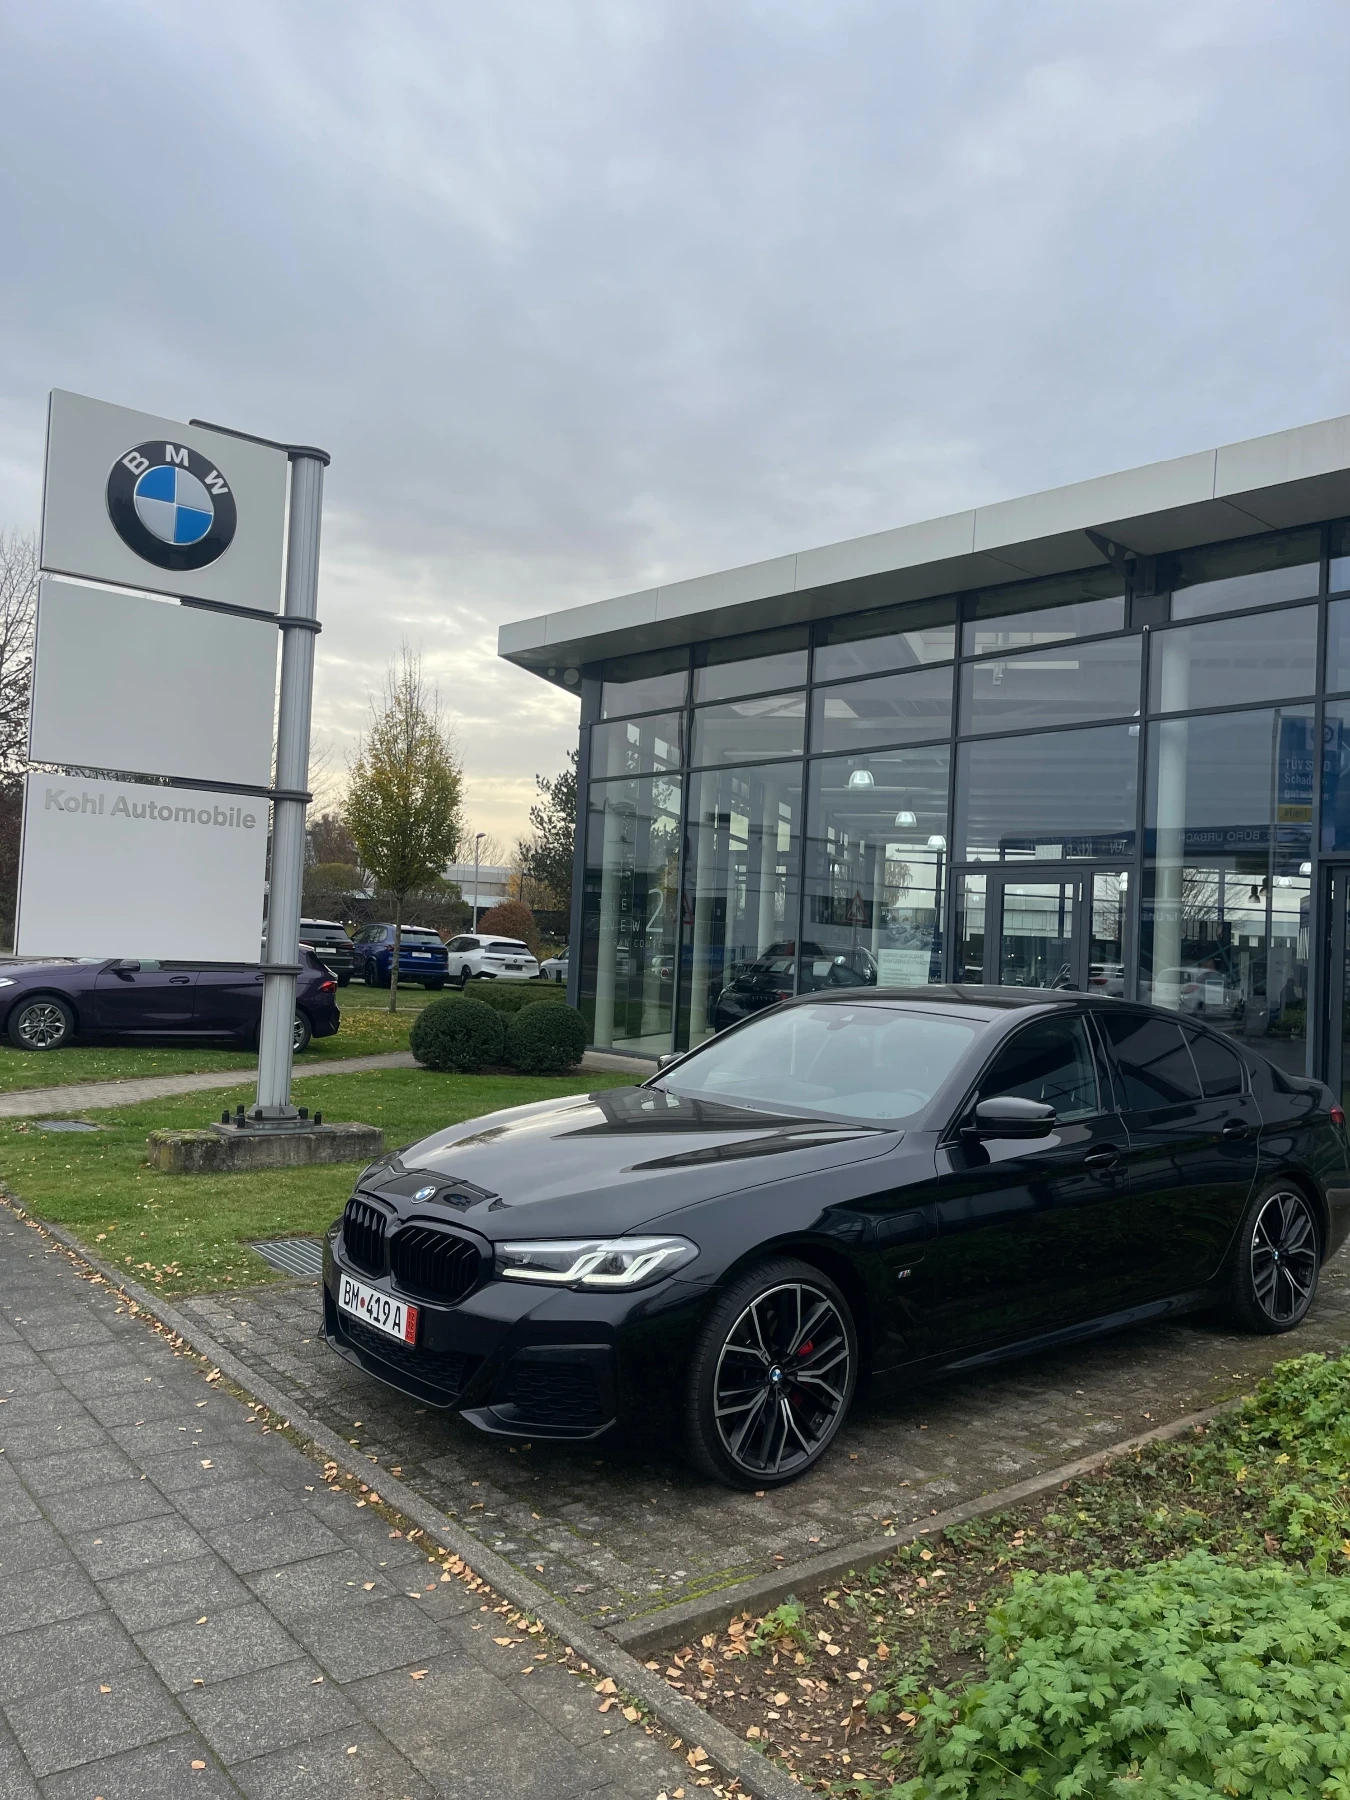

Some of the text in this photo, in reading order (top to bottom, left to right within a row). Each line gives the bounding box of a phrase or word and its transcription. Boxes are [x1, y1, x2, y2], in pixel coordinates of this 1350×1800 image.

[121, 444, 229, 495] BMW
[1306, 761, 1331, 772] SD
[45, 788, 256, 829] Kohl Automobile
